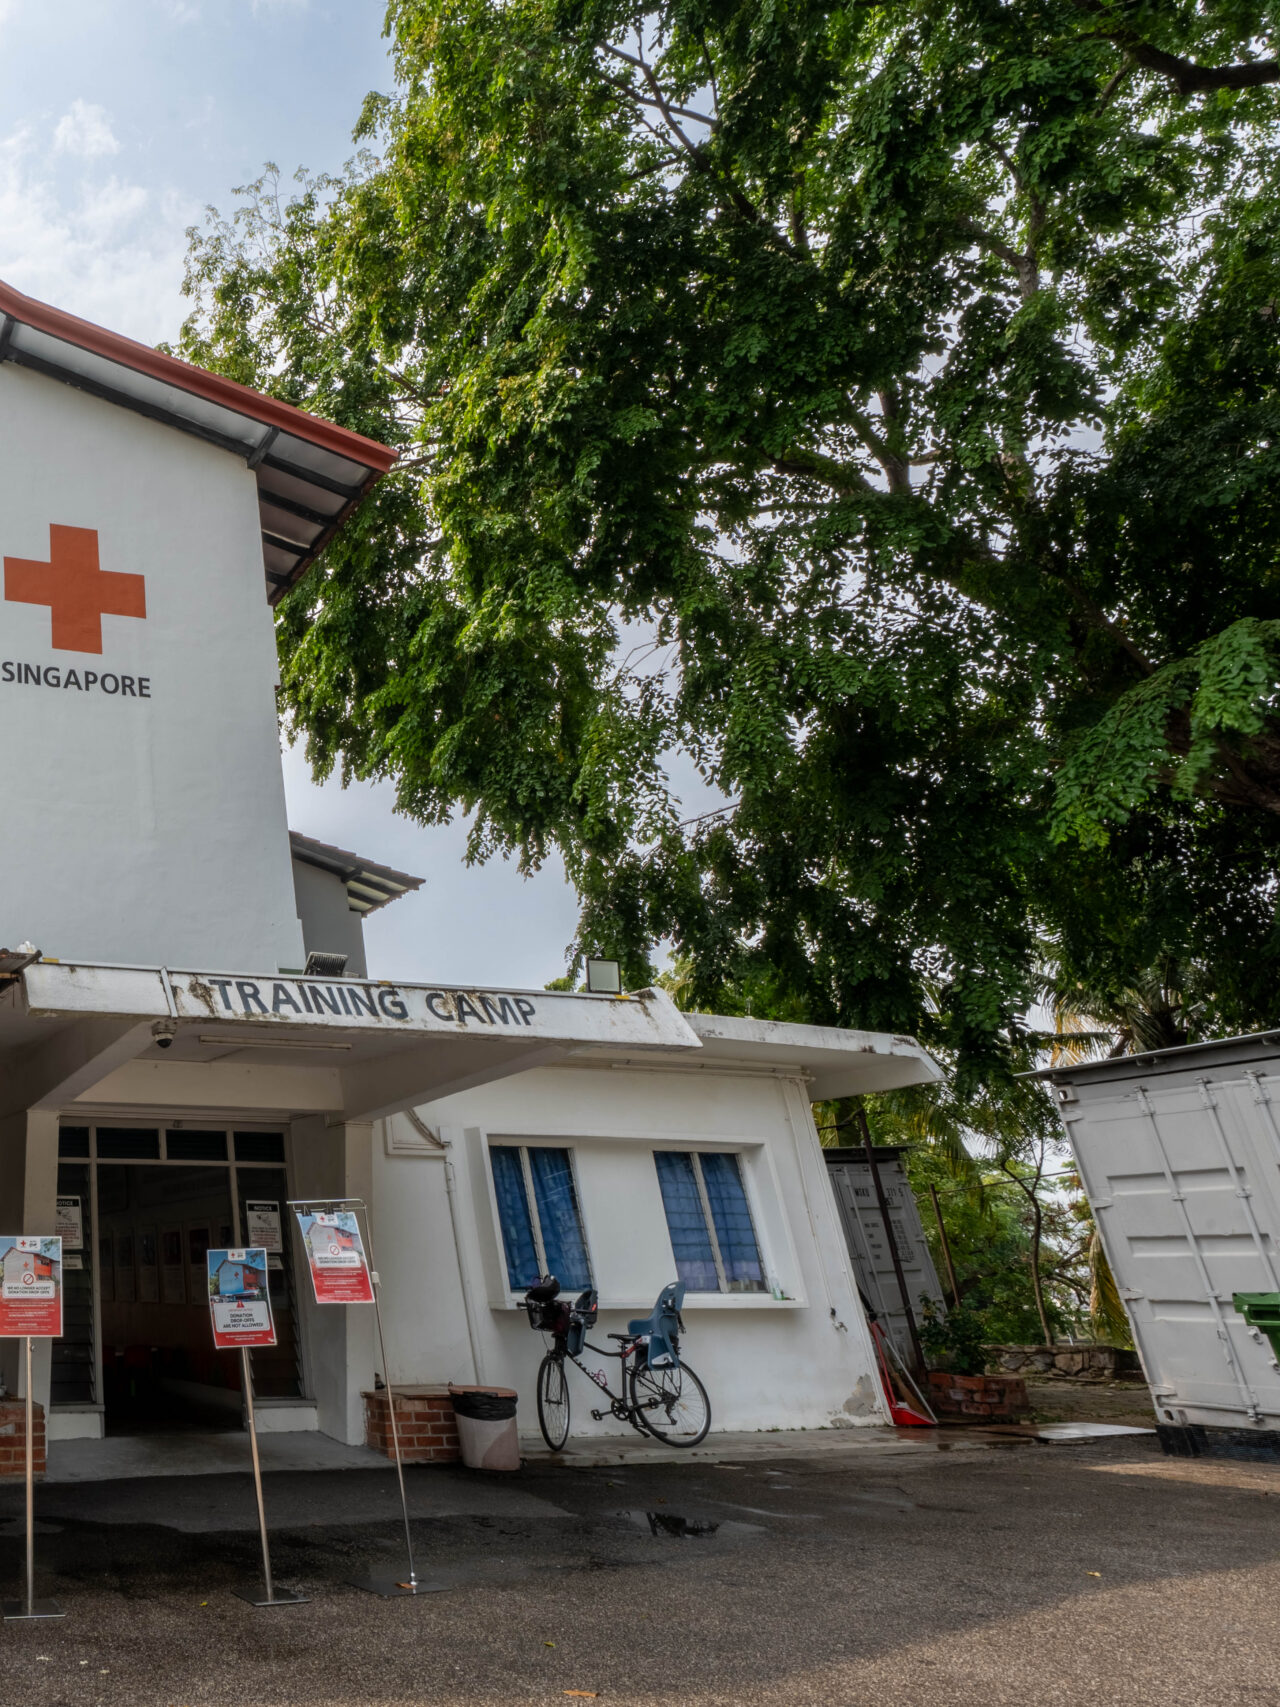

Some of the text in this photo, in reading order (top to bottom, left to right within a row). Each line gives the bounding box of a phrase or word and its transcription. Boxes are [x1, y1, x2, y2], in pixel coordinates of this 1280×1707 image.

[1, 660, 152, 699] SINGAPORE
[208, 978, 536, 1027] TRAINING CAMP
